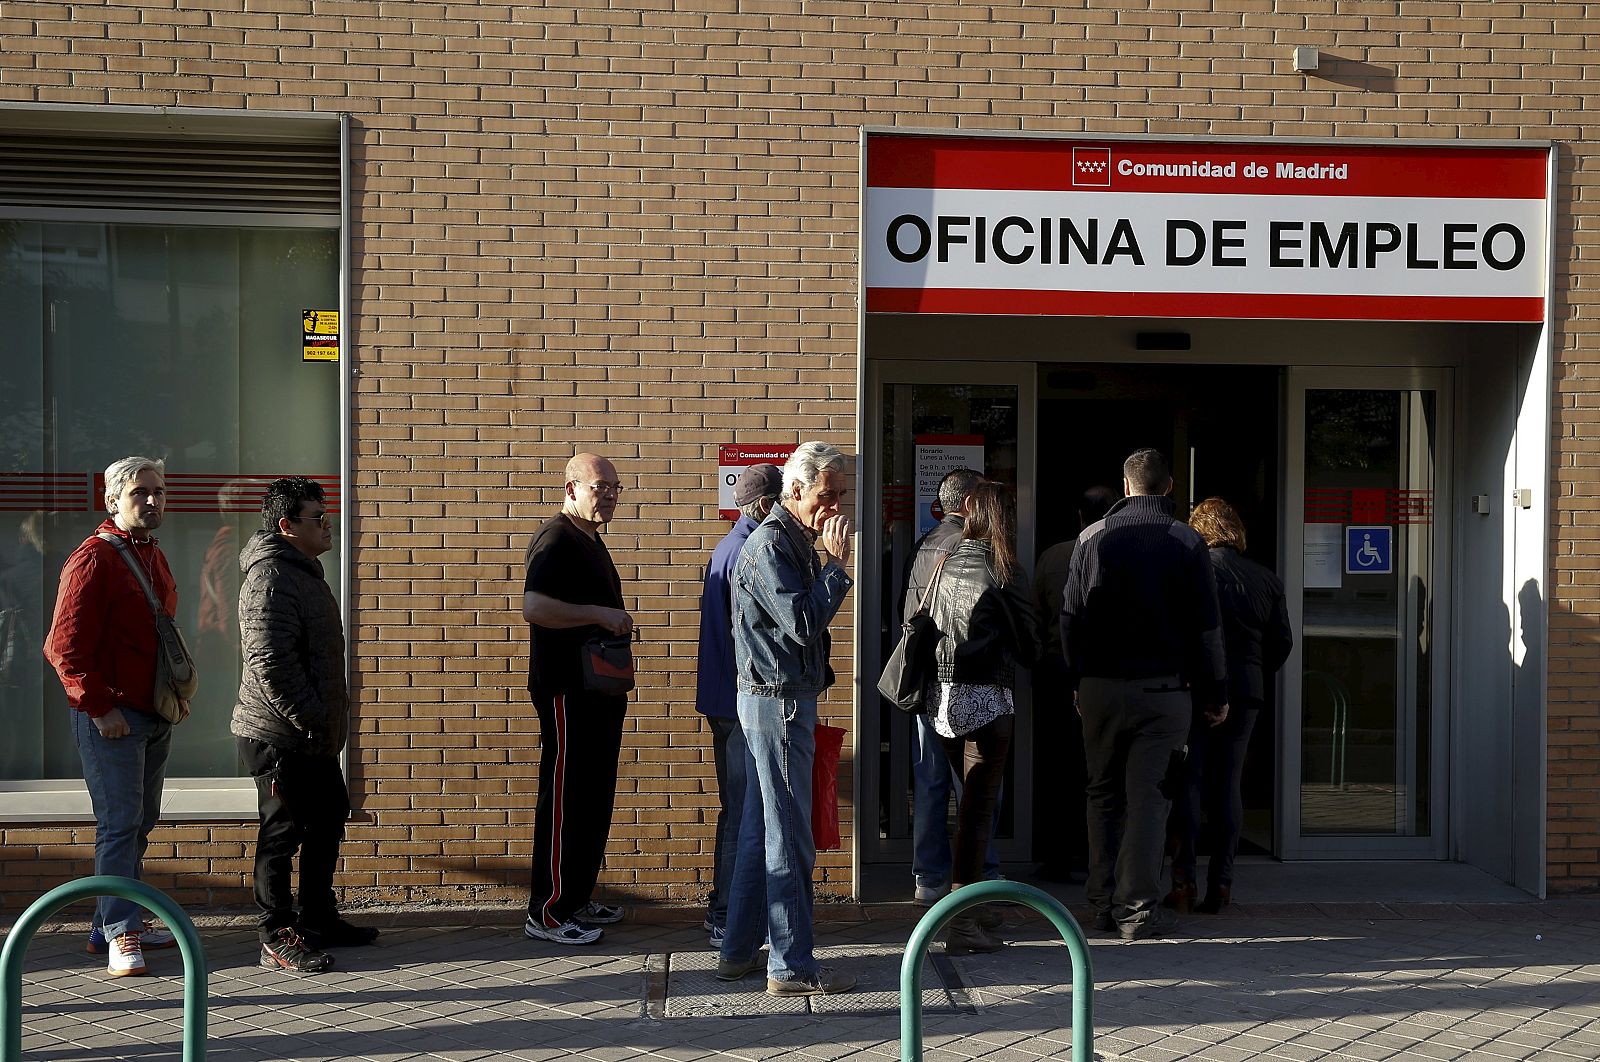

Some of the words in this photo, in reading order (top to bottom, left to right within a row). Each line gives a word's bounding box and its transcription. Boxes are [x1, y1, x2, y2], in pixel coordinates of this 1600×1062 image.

[1117, 159, 1236, 178] Comunidad
[1243, 163, 1269, 178] de
[1275, 162, 1348, 180] Madrid
[886, 214, 1146, 266] OFICINA
[1165, 219, 1247, 268] DE
[1269, 220, 1526, 271] EMPLEO
